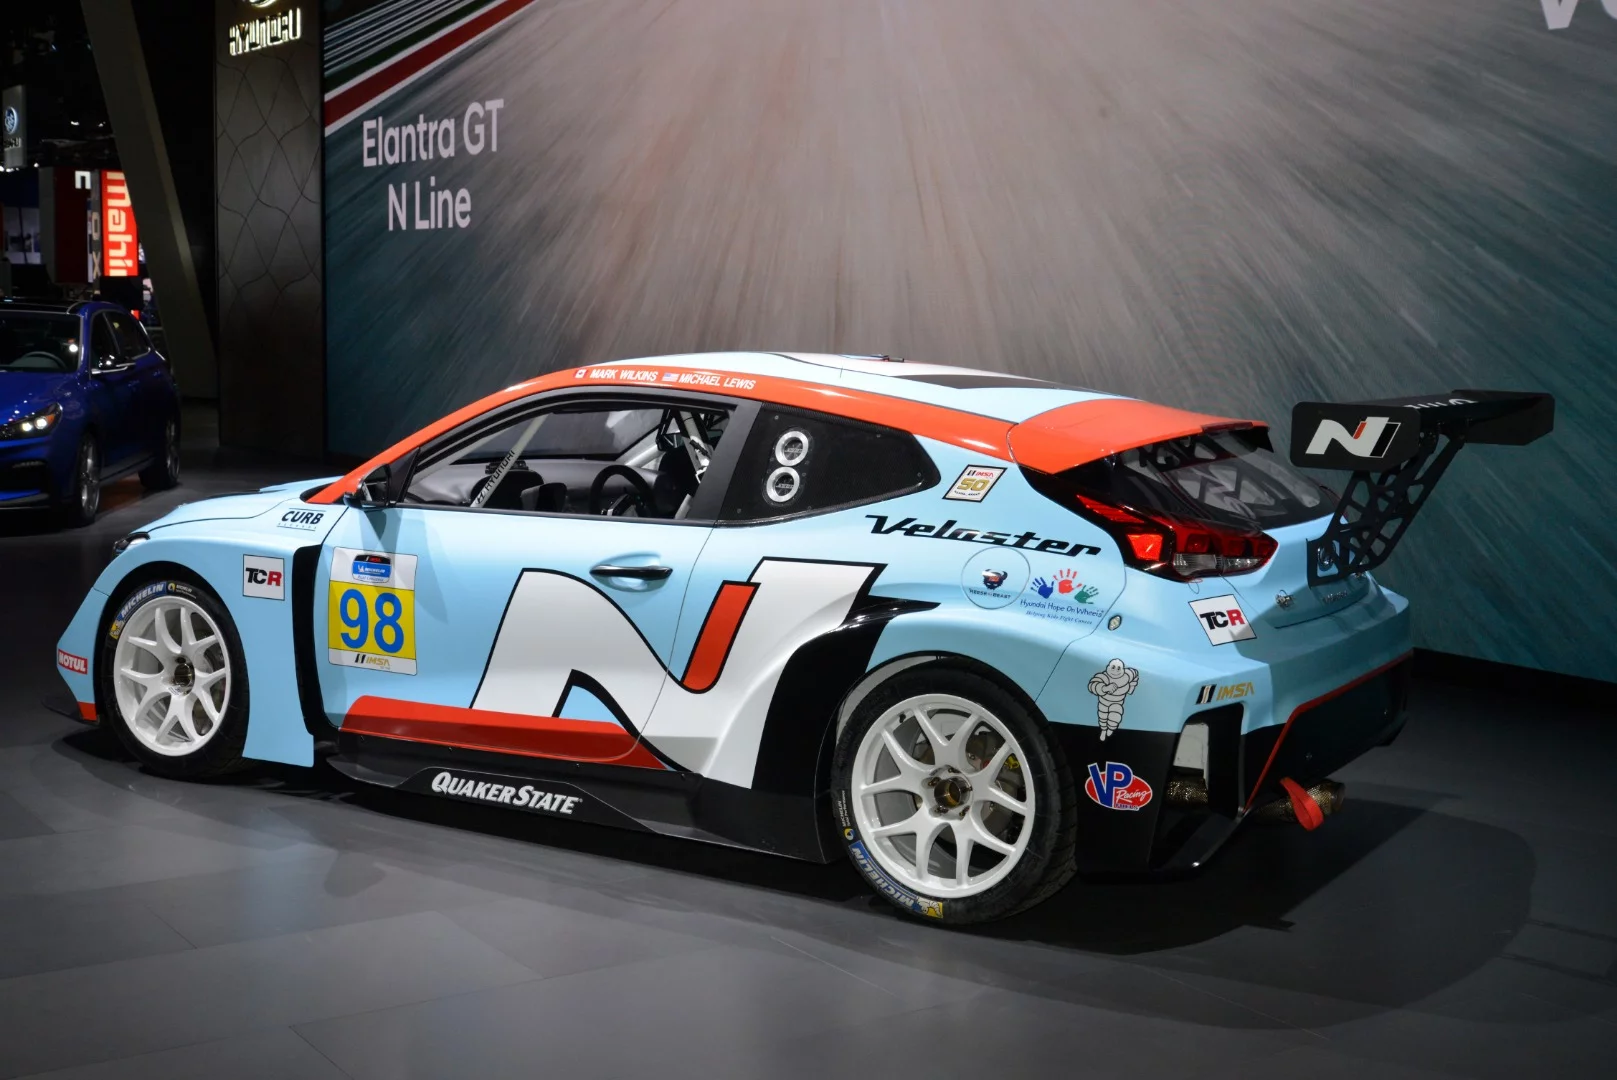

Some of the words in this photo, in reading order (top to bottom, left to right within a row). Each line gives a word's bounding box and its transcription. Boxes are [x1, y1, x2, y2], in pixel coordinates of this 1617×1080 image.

[363, 114, 455, 167] Elantra
[463, 99, 504, 155] GT
[388, 183, 407, 231] N
[415, 176, 471, 229] Line
[590, 369, 618, 380] MARK
[619, 370, 659, 382] WILKINS
[678, 373, 722, 387] MICHAEL
[723, 378, 757, 390] LEWIS
[957, 477, 990, 491] 50
[281, 510, 324, 525] CURB
[865, 514, 1102, 557] Veloster
[245, 567, 282, 586] TCR
[121, 583, 164, 618] MICHELIN
[1020, 599, 1046, 609] Hyundai
[1047, 602, 1065, 613] Hope
[339, 588, 405, 654] 98
[1200, 609, 1246, 630] TCR
[58, 652, 87, 672] MOTUL
[1216, 682, 1255, 700] IMSA
[1088, 761, 1134, 809] VP
[1115, 789, 1151, 804] Racing
[852, 847, 914, 906] MICHELIN
